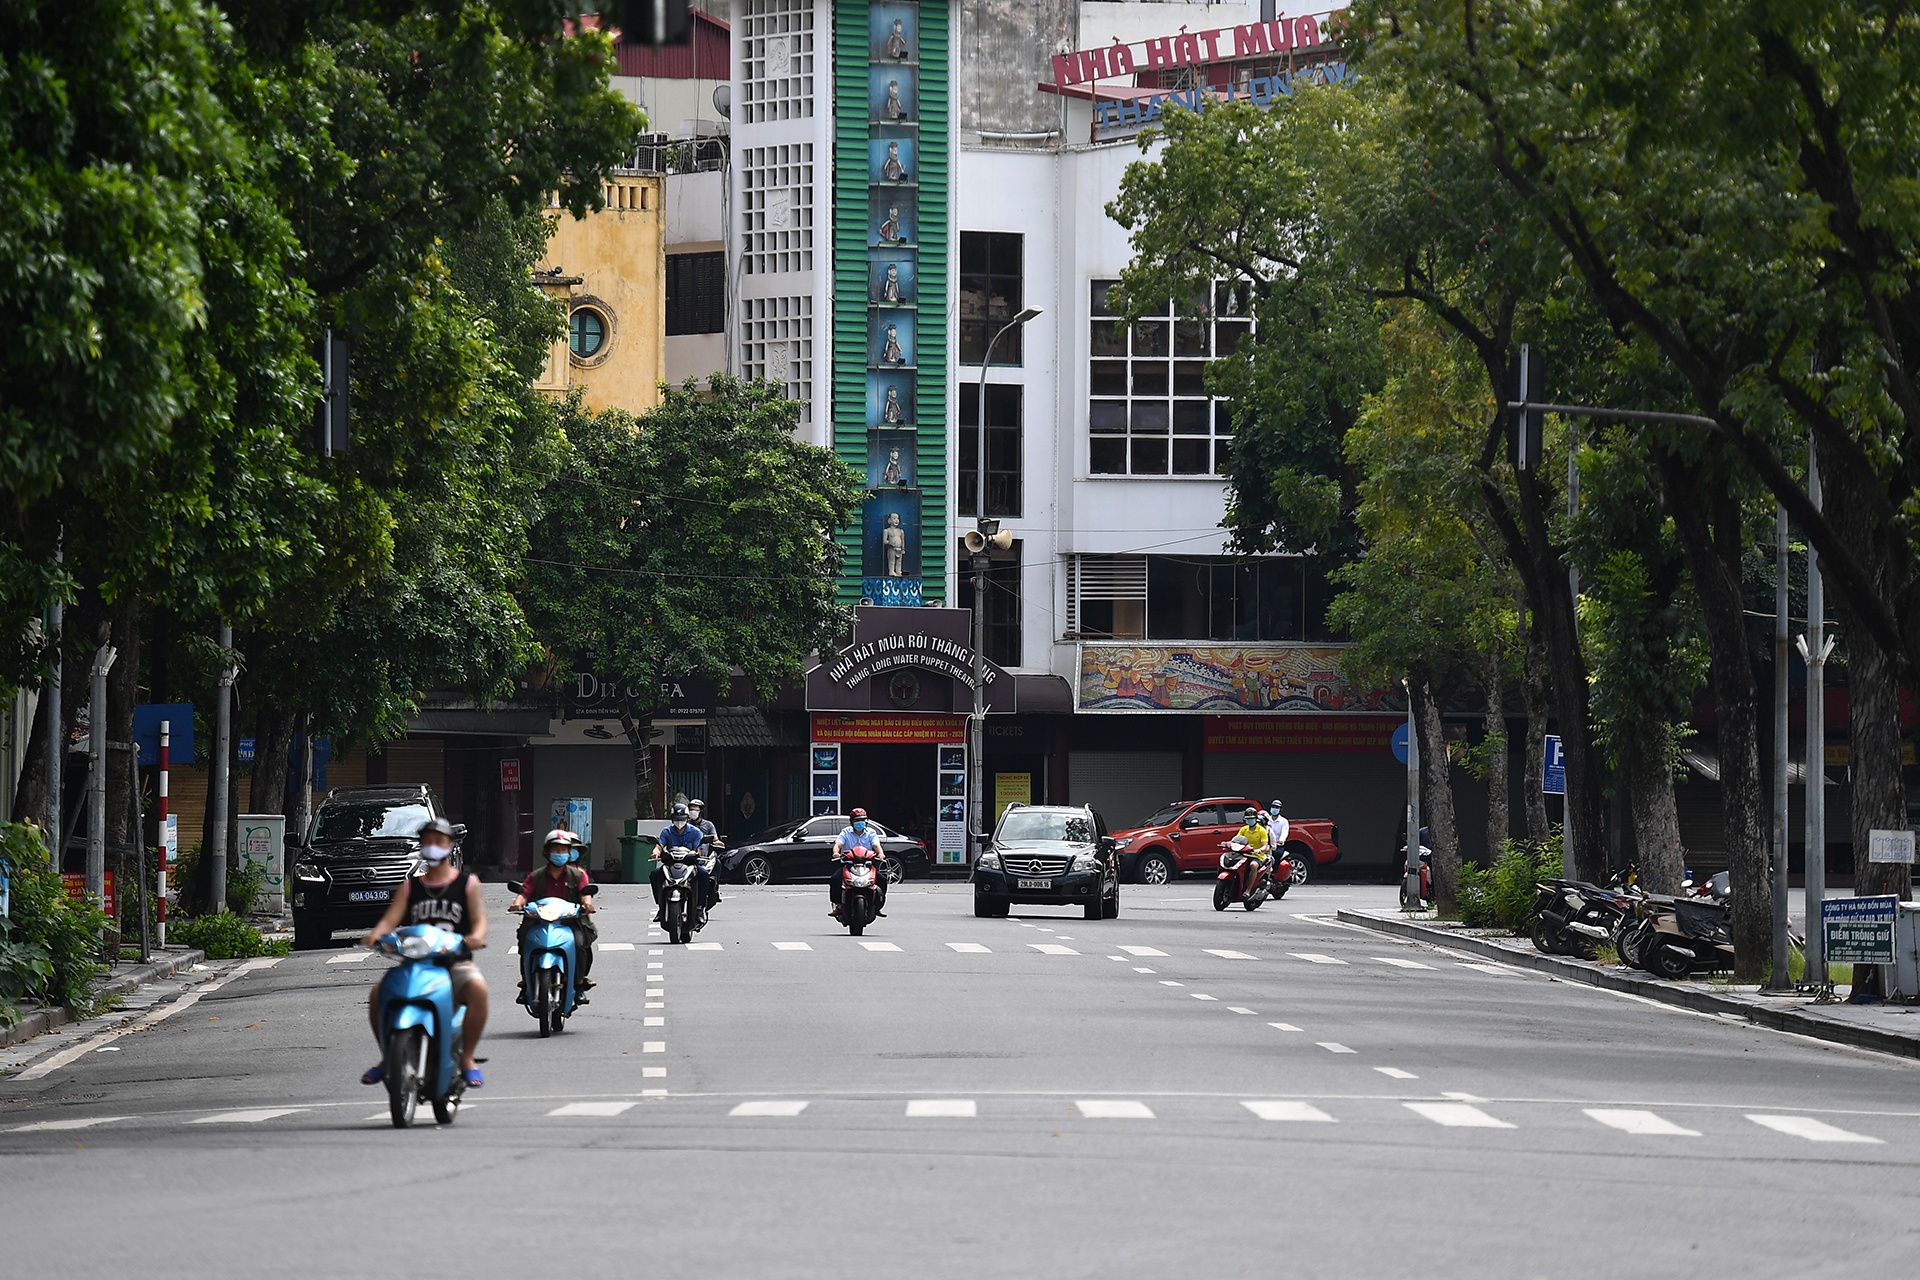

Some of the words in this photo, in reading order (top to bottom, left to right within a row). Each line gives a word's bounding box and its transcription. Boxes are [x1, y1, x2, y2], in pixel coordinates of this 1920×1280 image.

[1052, 36, 1134, 87] NHÀ
[1145, 24, 1221, 71] HÁT
[1234, 10, 1320, 58] MÚA
[829, 654, 855, 682] NHÀ
[853, 642, 875, 663] HÁT
[878, 633, 905, 653] MÚA
[908, 630, 928, 649] RỐI
[931, 638, 968, 662] THĂNG
[967, 654, 996, 685] LNG
[846, 667, 870, 689] THANG
[871, 657, 892, 672] LONG
[893, 654, 919, 664] WATER
[920, 655, 949, 670] PUPPET
[988, 726, 1024, 736] TICKETS
[1848, 902, 1856, 910] HÀ
[1830, 928, 1849, 940] ĐIỂM
[1851, 930, 1875, 941] TRÔNG
